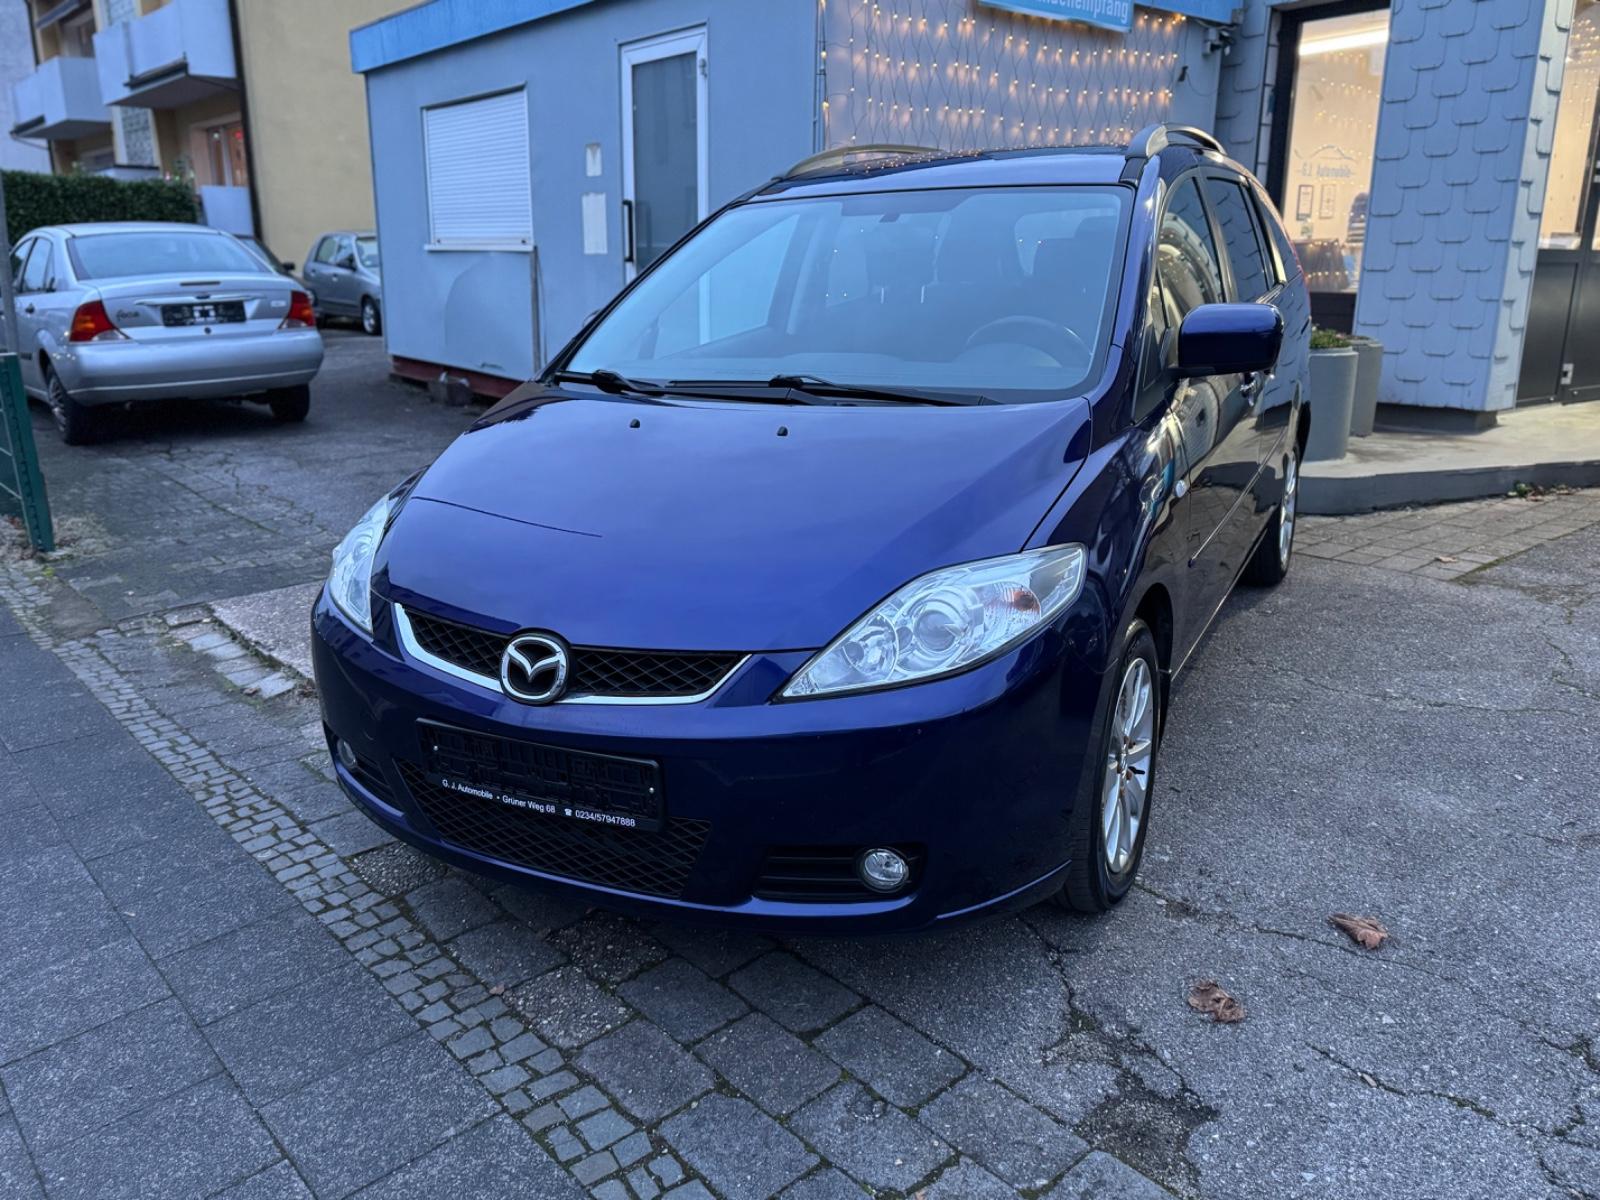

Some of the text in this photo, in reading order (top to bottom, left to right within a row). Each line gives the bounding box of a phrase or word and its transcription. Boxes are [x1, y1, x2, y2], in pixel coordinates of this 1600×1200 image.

[458, 783, 493, 799] Automobile
[502, 795, 526, 807] Grüner
[527, 801, 544, 813] Weg
[545, 804, 556, 813] 68
[575, 809, 636, 827] 0234/57947888
